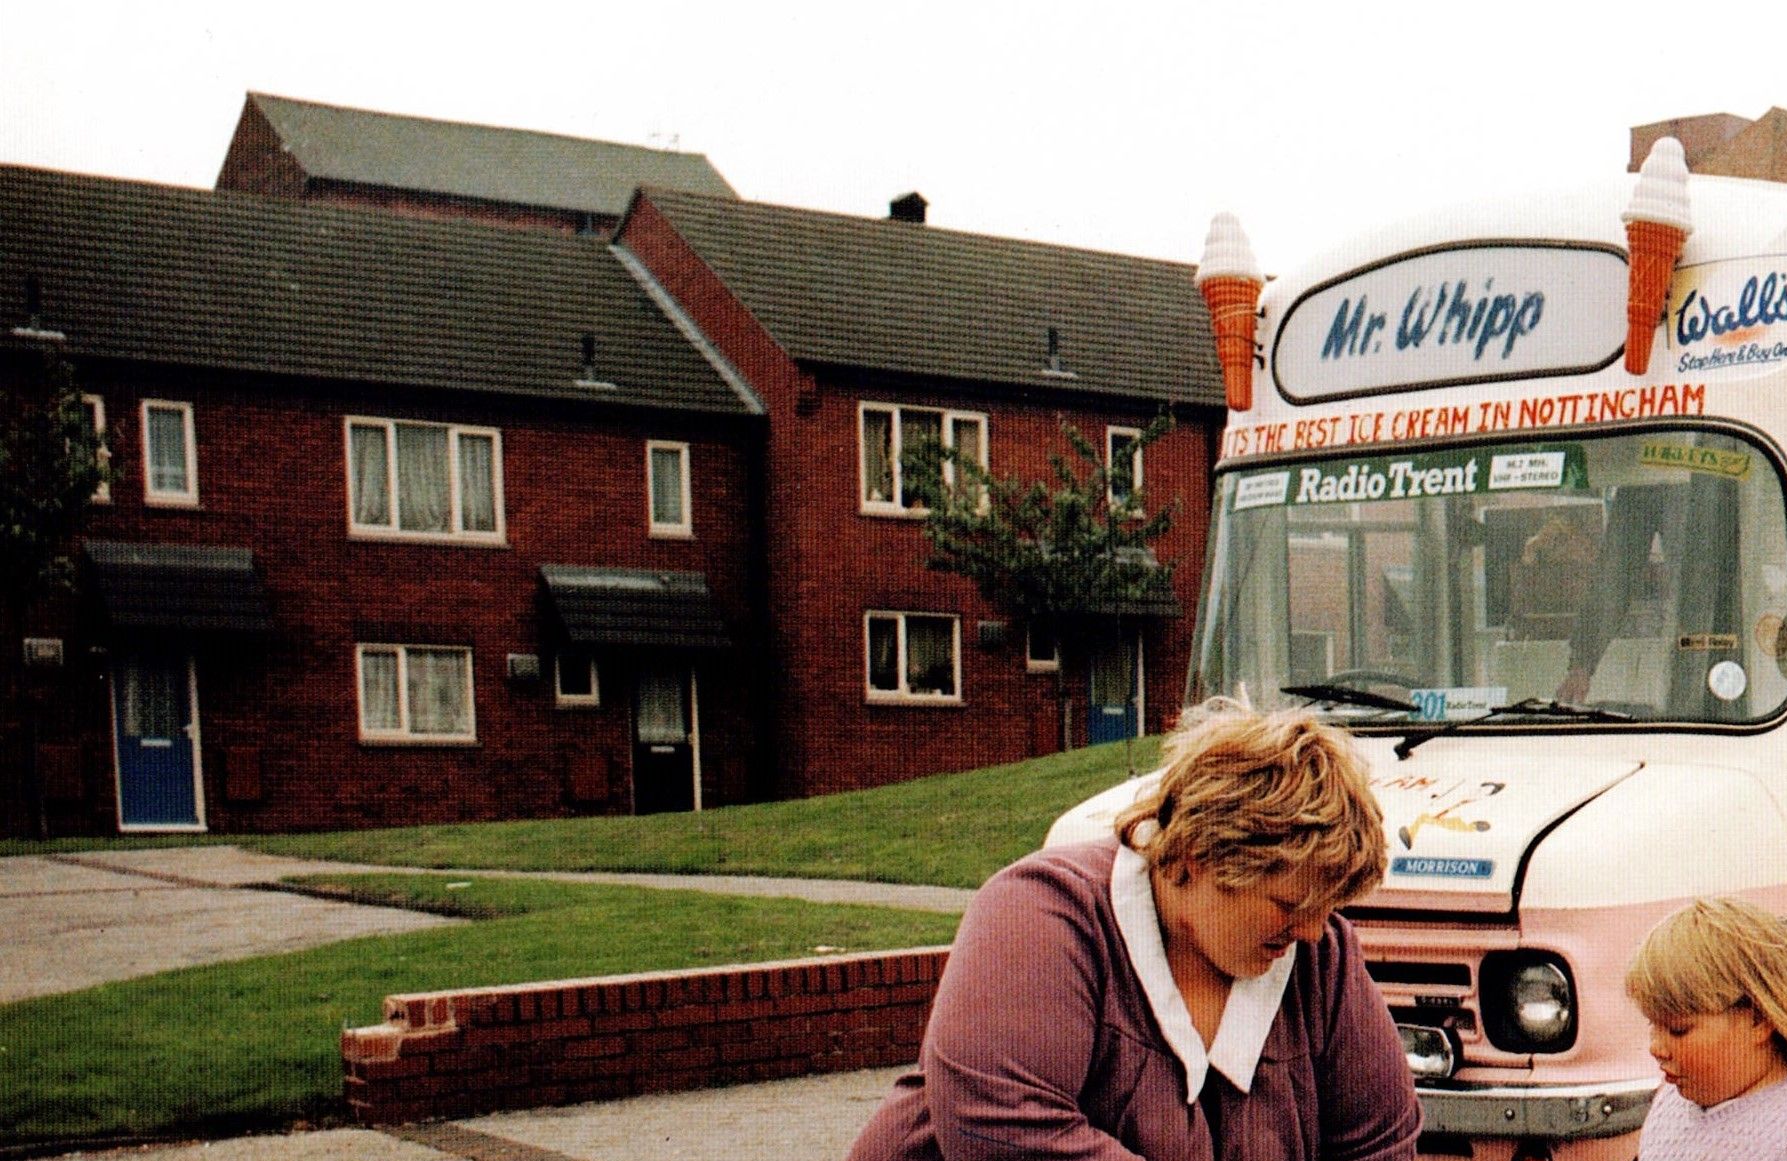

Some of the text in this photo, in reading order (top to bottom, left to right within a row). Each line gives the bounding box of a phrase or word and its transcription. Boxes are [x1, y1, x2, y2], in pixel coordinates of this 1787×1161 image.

[1321, 276, 1545, 361] Mr. Whipp
[1254, 423, 1288, 454] THE
[1294, 416, 1341, 450] BEST
[1348, 412, 1385, 444] ICE
[1391, 405, 1470, 441] CREAM
[1476, 400, 1511, 433] IN
[1518, 383, 1706, 429] NOTTINGHAM
[1296, 463, 1386, 503] Radio
[1388, 457, 1479, 498] Trent
[1405, 860, 1479, 874] MORRISON
